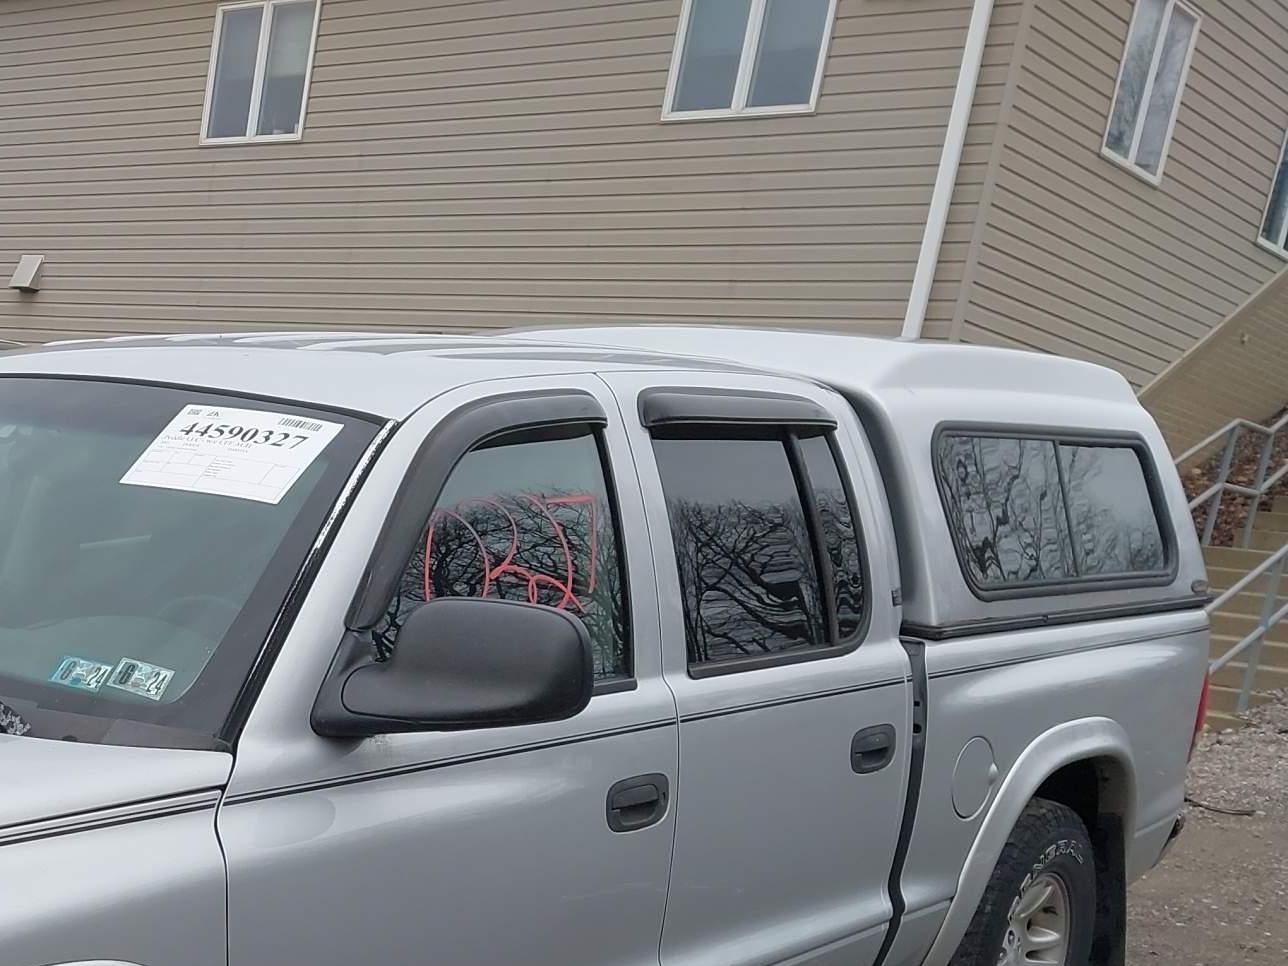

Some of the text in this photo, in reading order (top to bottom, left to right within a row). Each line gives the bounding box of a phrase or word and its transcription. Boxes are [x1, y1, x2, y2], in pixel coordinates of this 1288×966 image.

[179, 422, 310, 449] 44590327
[87, 667, 109, 688] 24
[146, 672, 168, 695] 24
